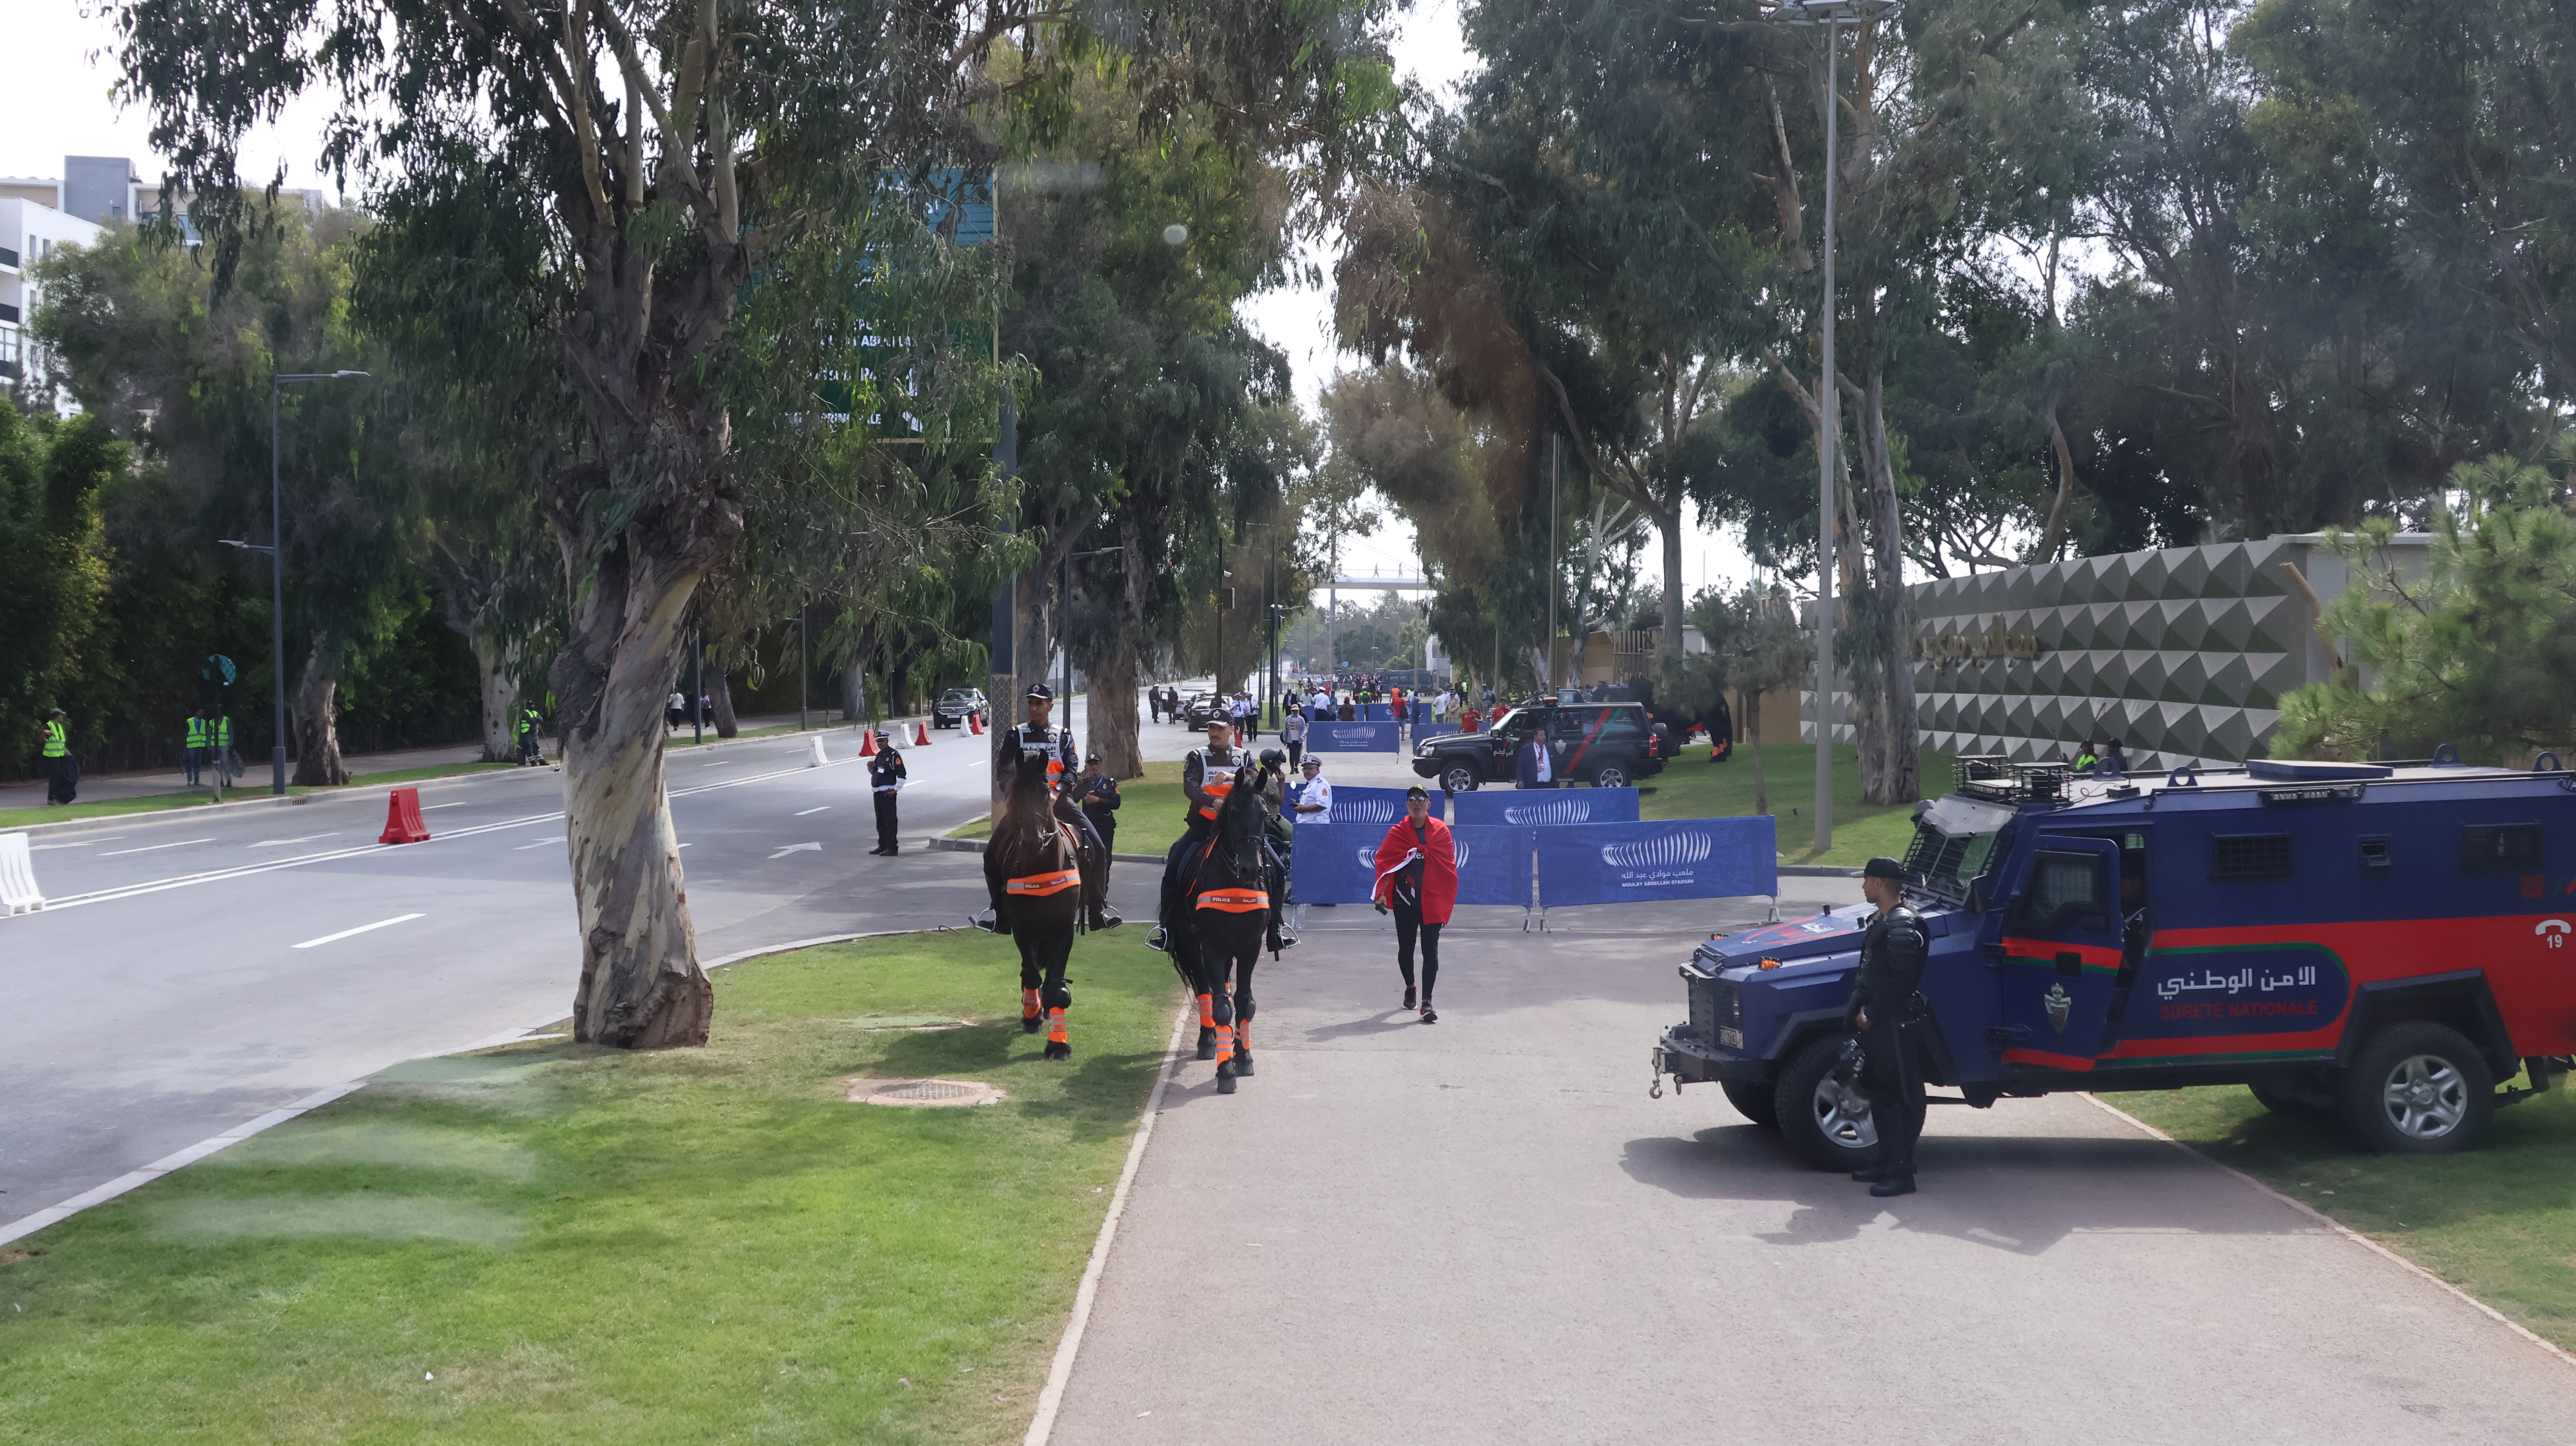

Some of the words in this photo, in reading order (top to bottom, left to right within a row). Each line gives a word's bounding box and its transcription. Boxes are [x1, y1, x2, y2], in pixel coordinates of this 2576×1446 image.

[1649, 870, 1671, 880] مولاي
[1673, 868, 1693, 878] ملعب
[2547, 934, 2563, 948] 19
[2158, 968, 2253, 999] الوطني
[2160, 1000, 2223, 1020] SÛRETÉ
[2228, 1000, 2318, 1018] NATIONALE
